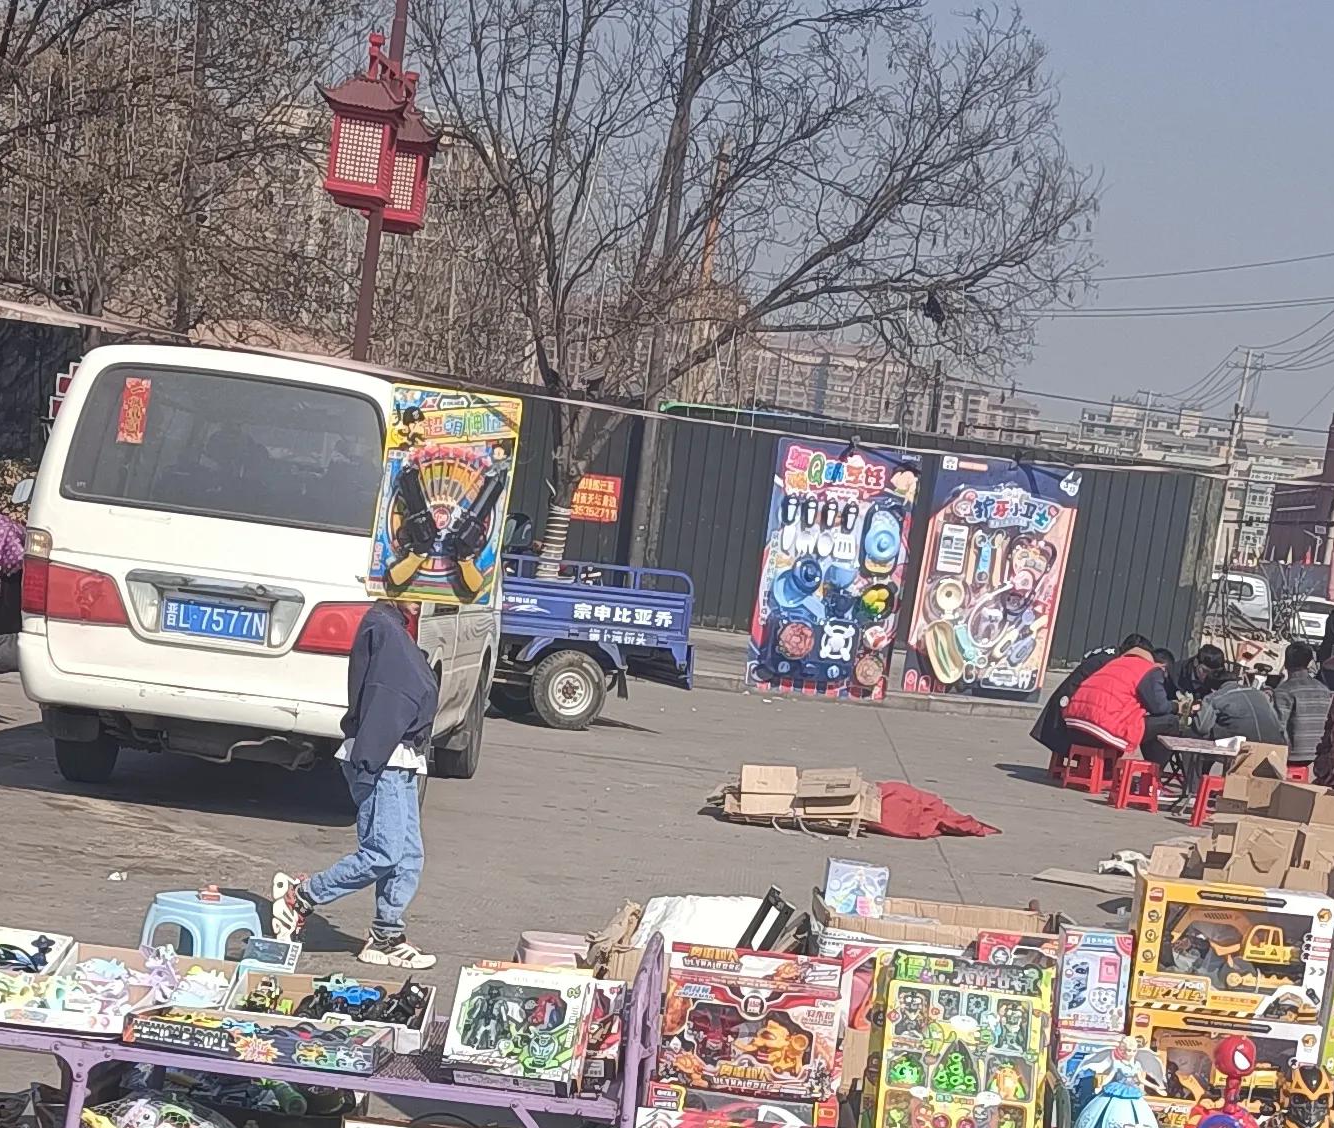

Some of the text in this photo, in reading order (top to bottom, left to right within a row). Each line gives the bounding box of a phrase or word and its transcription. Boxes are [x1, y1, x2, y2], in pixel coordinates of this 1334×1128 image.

[573, 602, 673, 627] 宗申比亚乔
